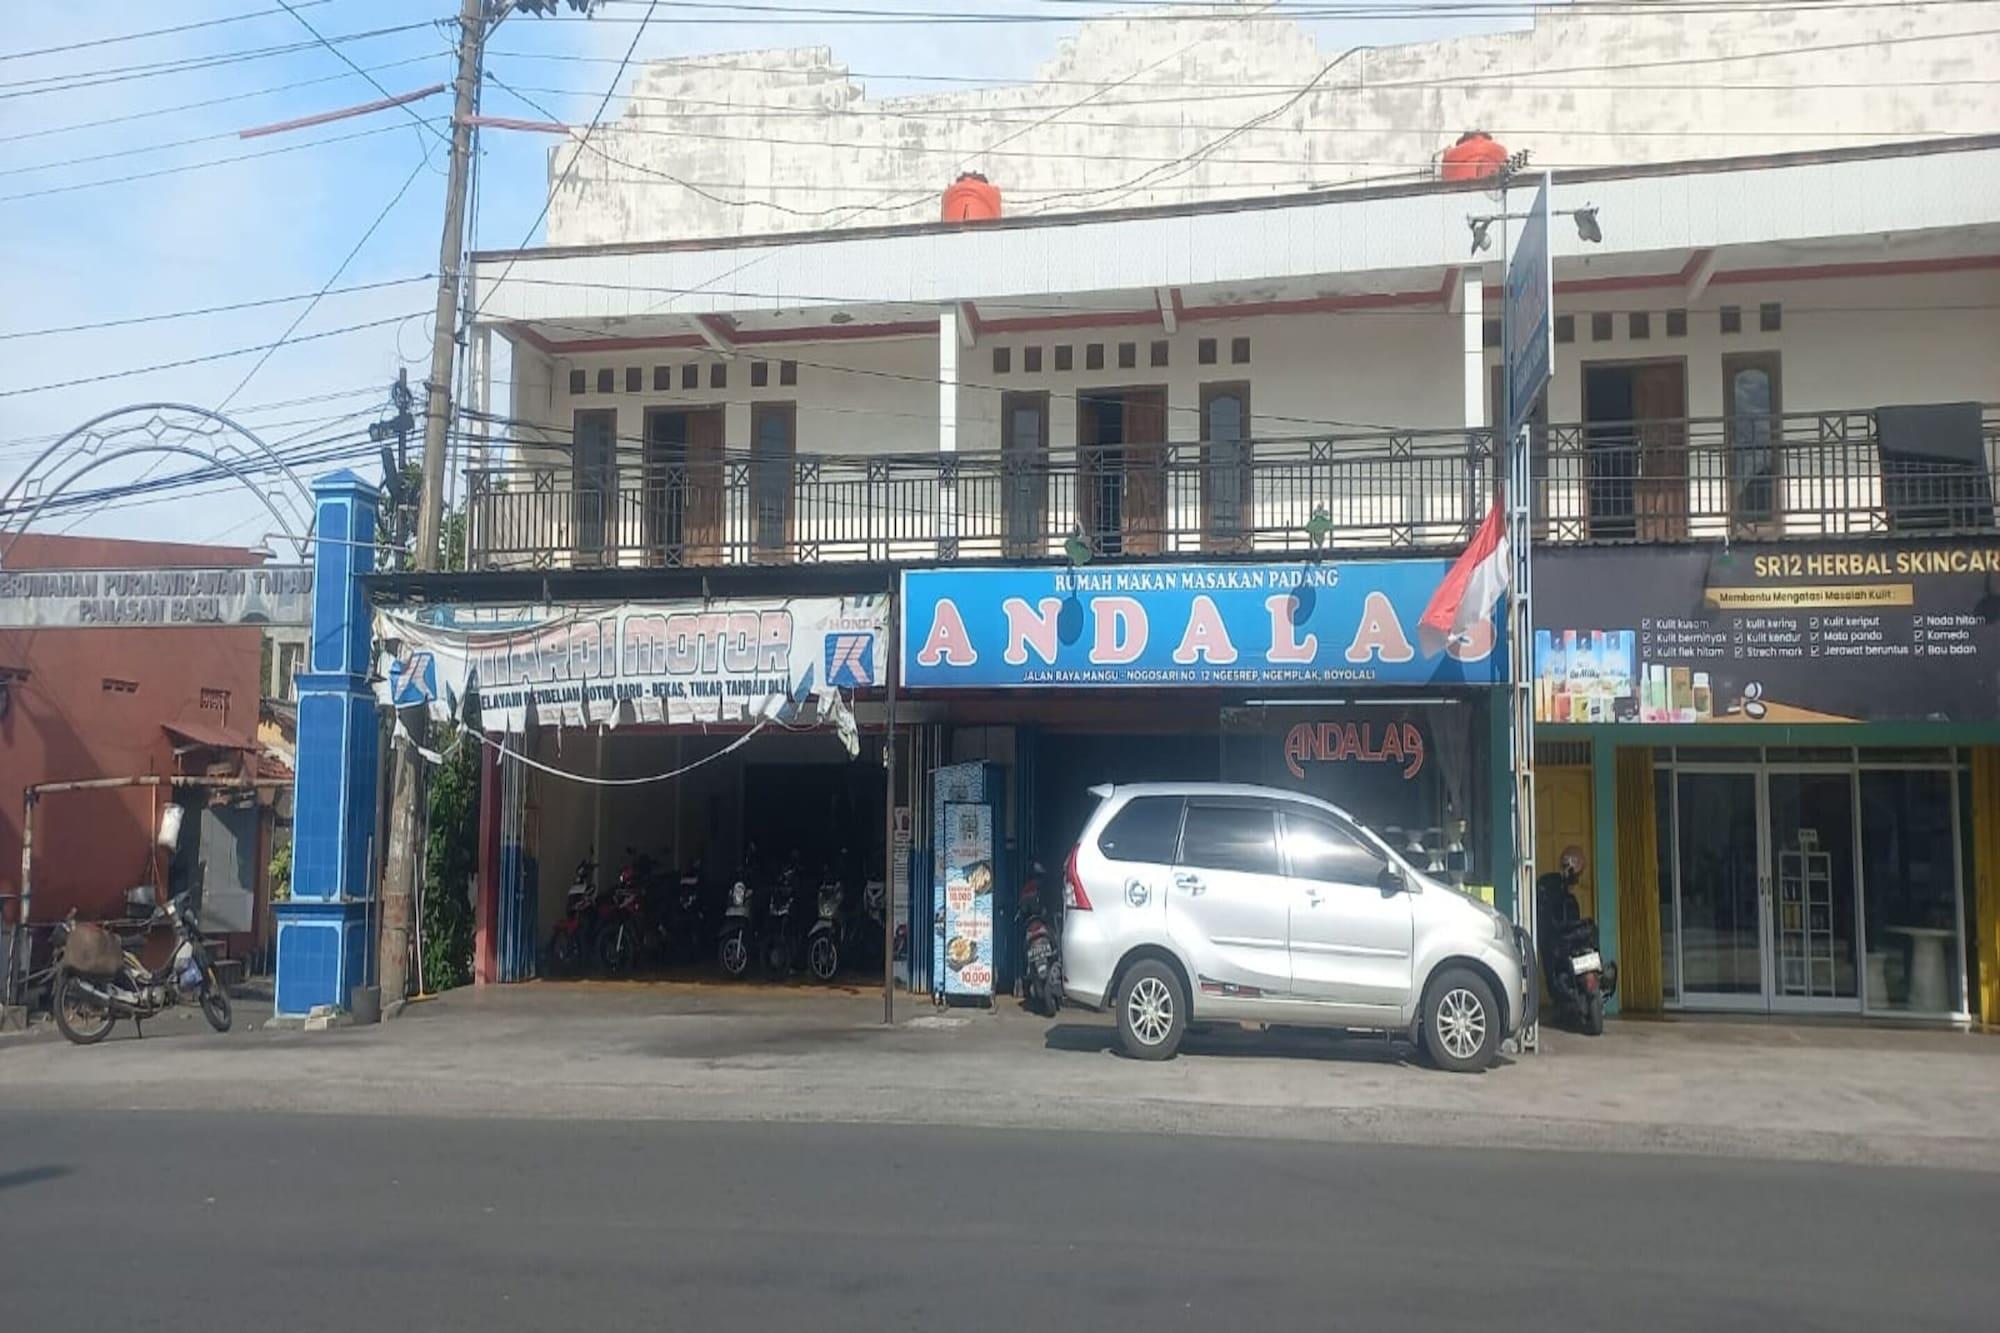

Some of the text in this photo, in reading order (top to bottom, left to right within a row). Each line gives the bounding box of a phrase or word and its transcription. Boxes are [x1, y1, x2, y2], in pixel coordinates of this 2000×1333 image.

[1754, 554, 1802, 577] SR12
[1807, 553, 1892, 576] HERBAL
[104, 572, 245, 597] PURNAWIRAWAN
[1055, 569, 1339, 592] RUMAH MAKAN MASAKAN PADANG
[1720, 592, 1771, 603] Membantu
[1773, 592, 1823, 605] Mengatasi
[1825, 590, 1867, 601] Masalah
[80, 598, 220, 622] PANASAN BARU
[1657, 618, 1709, 630] Kulit kusam
[1768, 618, 1797, 631] kering
[1823, 616, 1880, 630] Kulit keriput
[1927, 614, 1986, 627] Noda hitam
[1657, 631, 1727, 646] Kulit berminyak
[1747, 631, 1801, 643] Kulit kendur
[1824, 630, 1882, 644] Mata panda
[1927, 629, 1970, 641] Komedo
[622, 609, 794, 677] MOTOR
[1824, 644, 1909, 656] Jerawat beruntus
[1658, 646, 1724, 657] Kulit flek hitam
[1747, 646, 1803, 658] Strech mark
[1928, 645, 1948, 656] Bau
[1023, 670, 1053, 682] JALAN
[1056, 670, 1080, 681] RAYA
[1083, 670, 1119, 681] MANGU
[1127, 669, 1178, 681] NOGOSARI
[1201, 669, 1210, 681] 12
[1263, 669, 1321, 682] NGEMPLAK,
[1324, 668, 1376, 681] BOYOLALI
[616, 682, 643, 700] BARU
[689, 680, 723, 697] TUKAR
[725, 679, 766, 696] TAMBAH
[1285, 722, 1424, 780] ANDALAS
